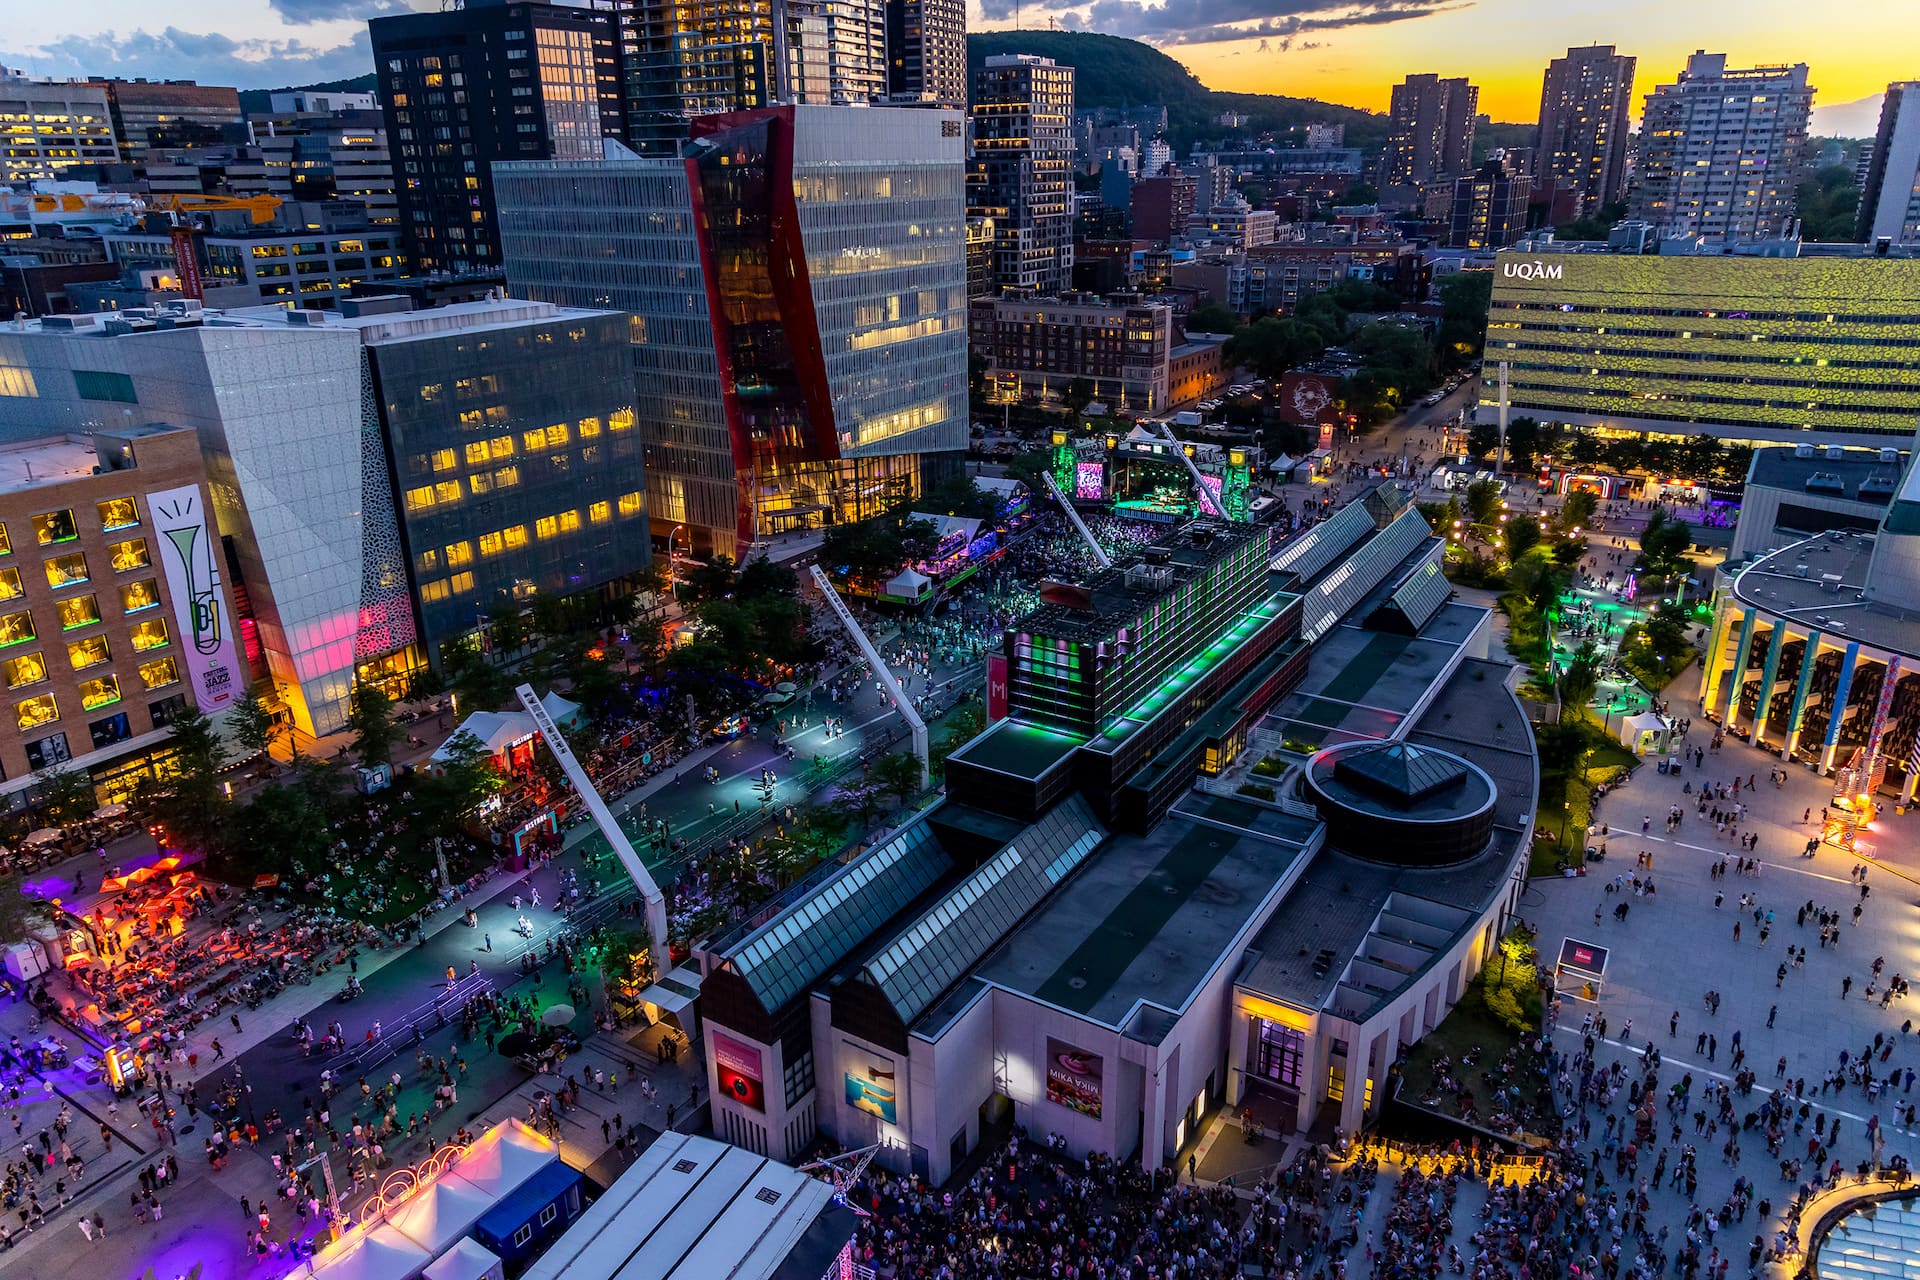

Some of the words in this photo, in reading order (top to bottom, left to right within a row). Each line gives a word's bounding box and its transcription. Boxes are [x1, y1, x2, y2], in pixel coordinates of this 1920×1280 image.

[1504, 260, 1562, 281] UQÀM
[205, 672, 231, 689] JAZZ
[1050, 1069, 1073, 1084] MIKA
